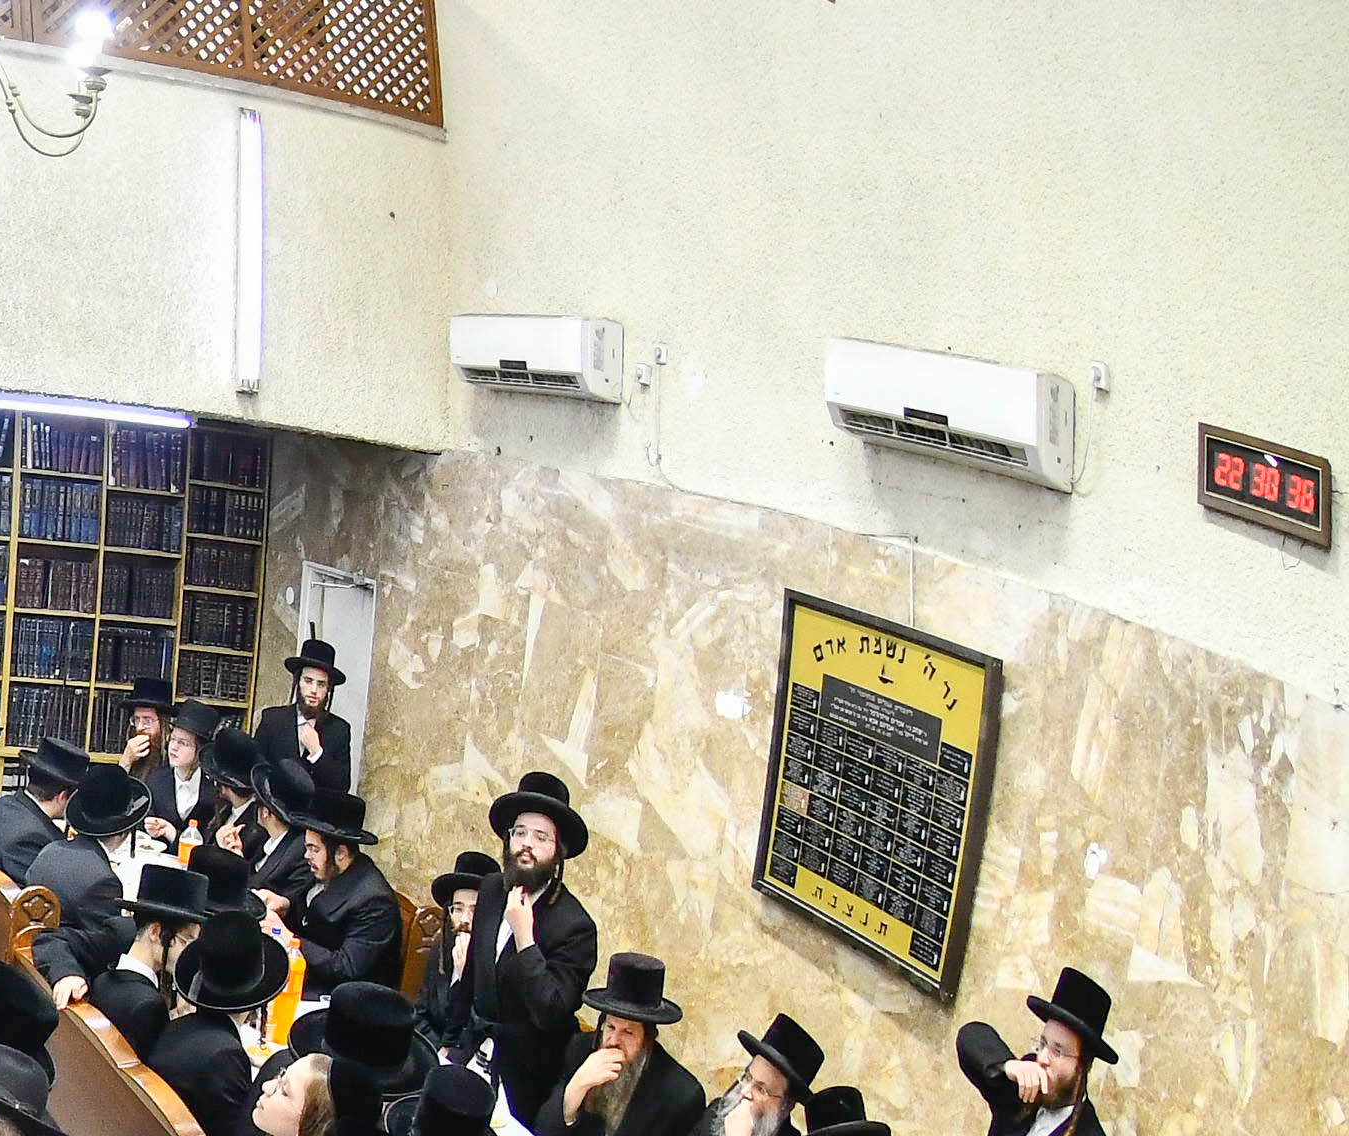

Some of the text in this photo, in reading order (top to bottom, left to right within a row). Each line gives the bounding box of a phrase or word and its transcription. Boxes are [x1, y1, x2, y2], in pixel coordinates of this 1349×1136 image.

[1213, 451, 1246, 491] 22
[1251, 462, 1282, 503] 30
[812, 636, 958, 711] נר ה' נשמת אדם
